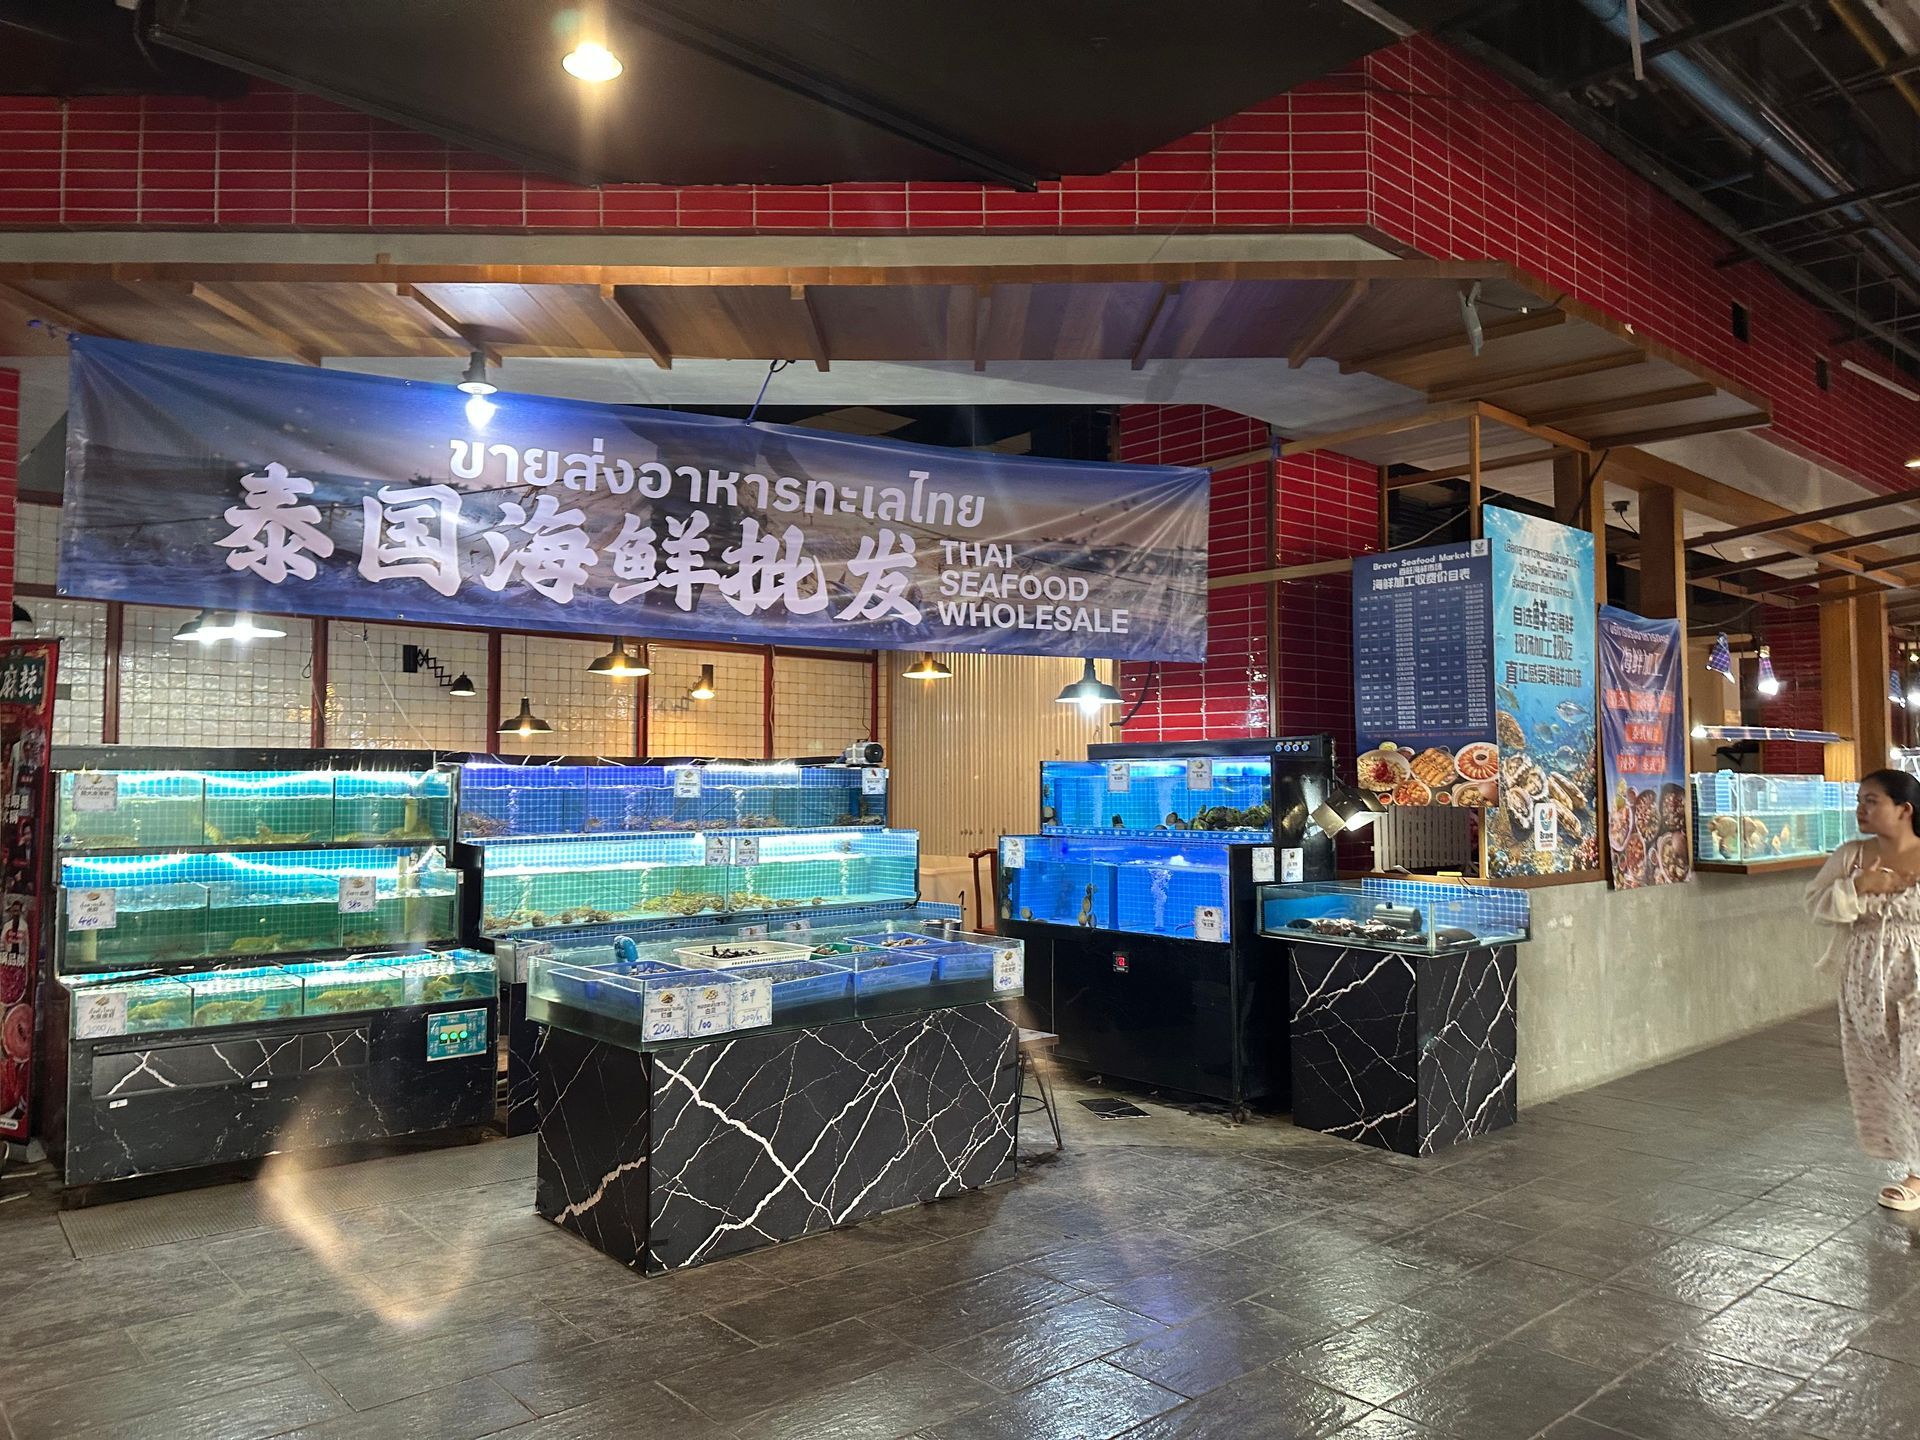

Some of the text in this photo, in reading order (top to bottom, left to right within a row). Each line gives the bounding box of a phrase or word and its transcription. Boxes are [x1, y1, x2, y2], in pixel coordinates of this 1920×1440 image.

[449, 438, 985, 528] ขายส่งอาหารทะเลไทย
[214, 462, 922, 626] 泰国海鲜批发
[940, 539, 1012, 568] THAI
[1373, 562, 1398, 571] Bravo
[1401, 555, 1436, 567] Seafood
[1439, 551, 1470, 562] Market
[939, 570, 1089, 601] SEAFOOD
[1372, 568, 1471, 591] 海鲜加工收费价目表
[937, 601, 1129, 635] WHOLESALE
[1505, 660, 1582, 689] 真正感受海鲜本味
